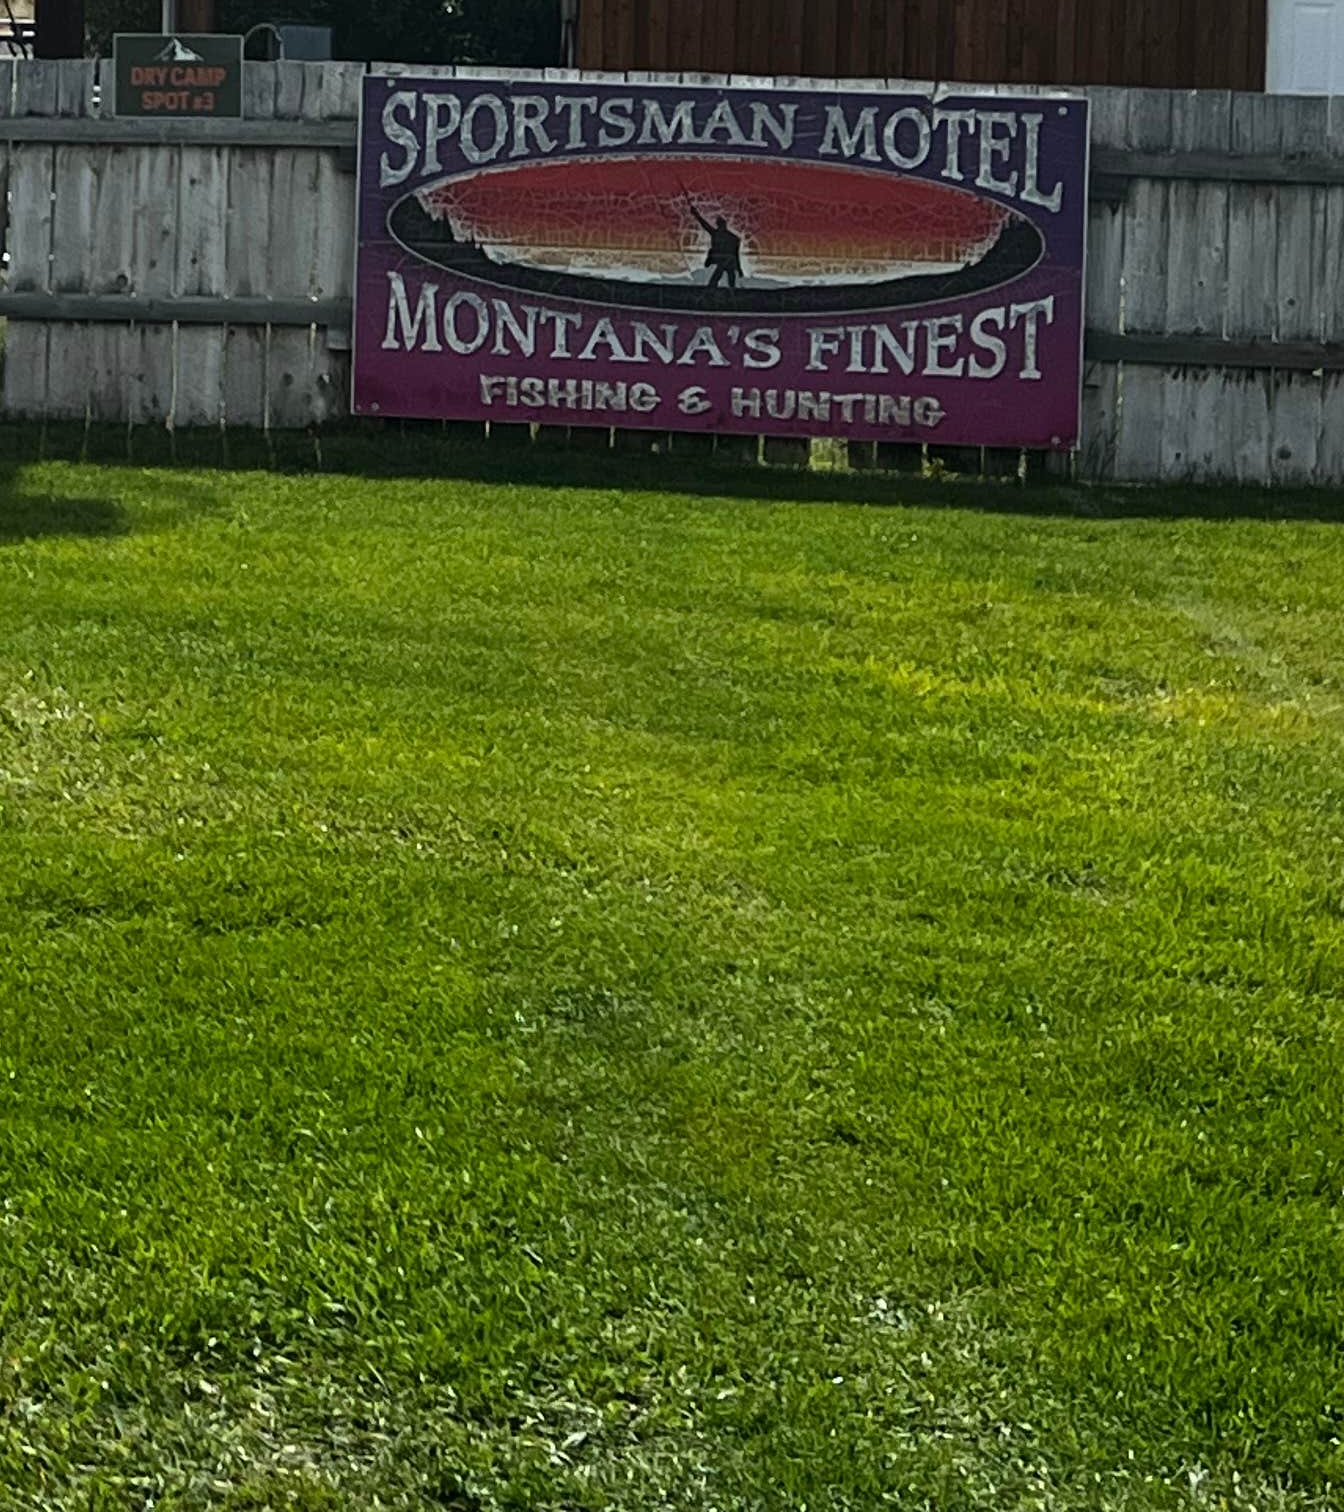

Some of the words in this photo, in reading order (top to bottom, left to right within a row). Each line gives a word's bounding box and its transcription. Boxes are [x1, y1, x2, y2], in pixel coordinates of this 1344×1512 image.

[131, 67, 167, 86] DRY
[171, 67, 226, 87] CAMP
[142, 91, 190, 110] SPOT
[379, 90, 799, 187] SPORTSMAN
[817, 103, 1064, 214] MOTEL
[381, 270, 782, 370] MONTANA'S
[806, 295, 1055, 381] FINEST
[479, 374, 662, 413] FISHING
[677, 385, 712, 414] &
[731, 388, 948, 429] HUNTING
